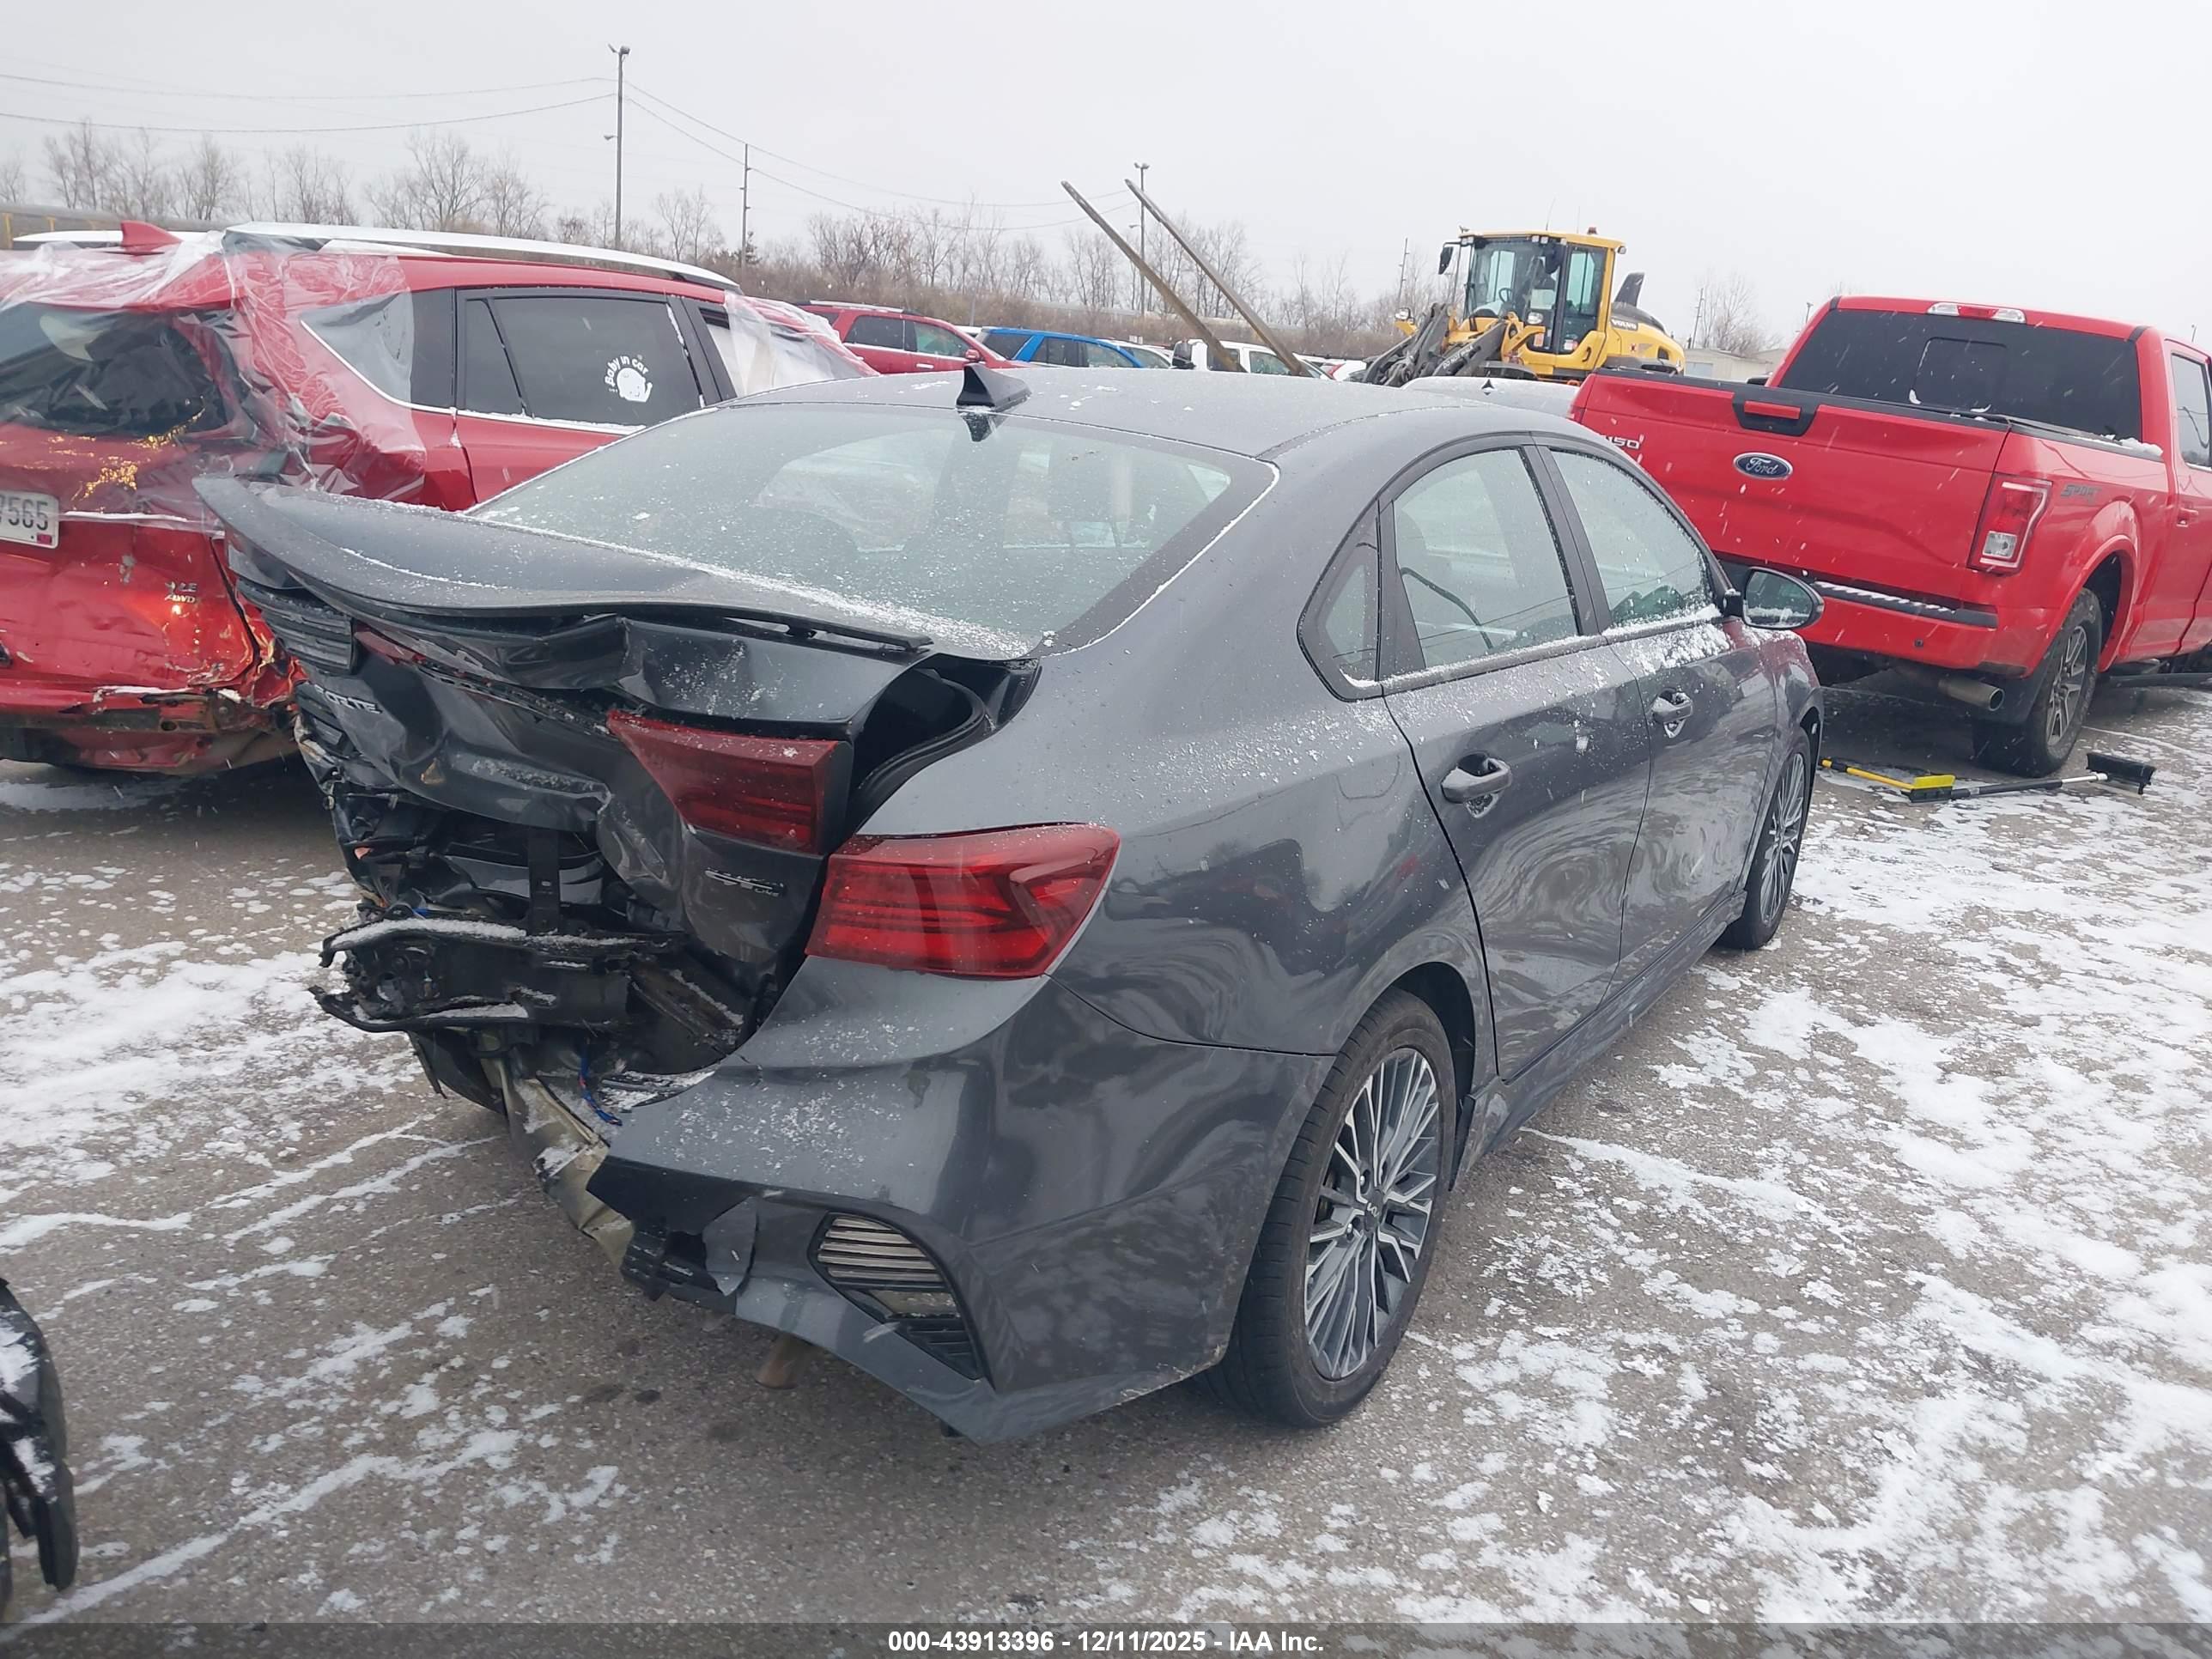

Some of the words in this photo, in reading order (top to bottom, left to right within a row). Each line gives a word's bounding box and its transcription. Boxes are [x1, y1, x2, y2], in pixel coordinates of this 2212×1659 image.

[1611, 319, 1638, 330] VOLVO
[605, 357, 621, 387] Baby
[631, 358, 649, 374] car
[1745, 457, 1779, 475] Ford
[164, 594, 196, 603] AWD
[314, 684, 380, 714] FORTE
